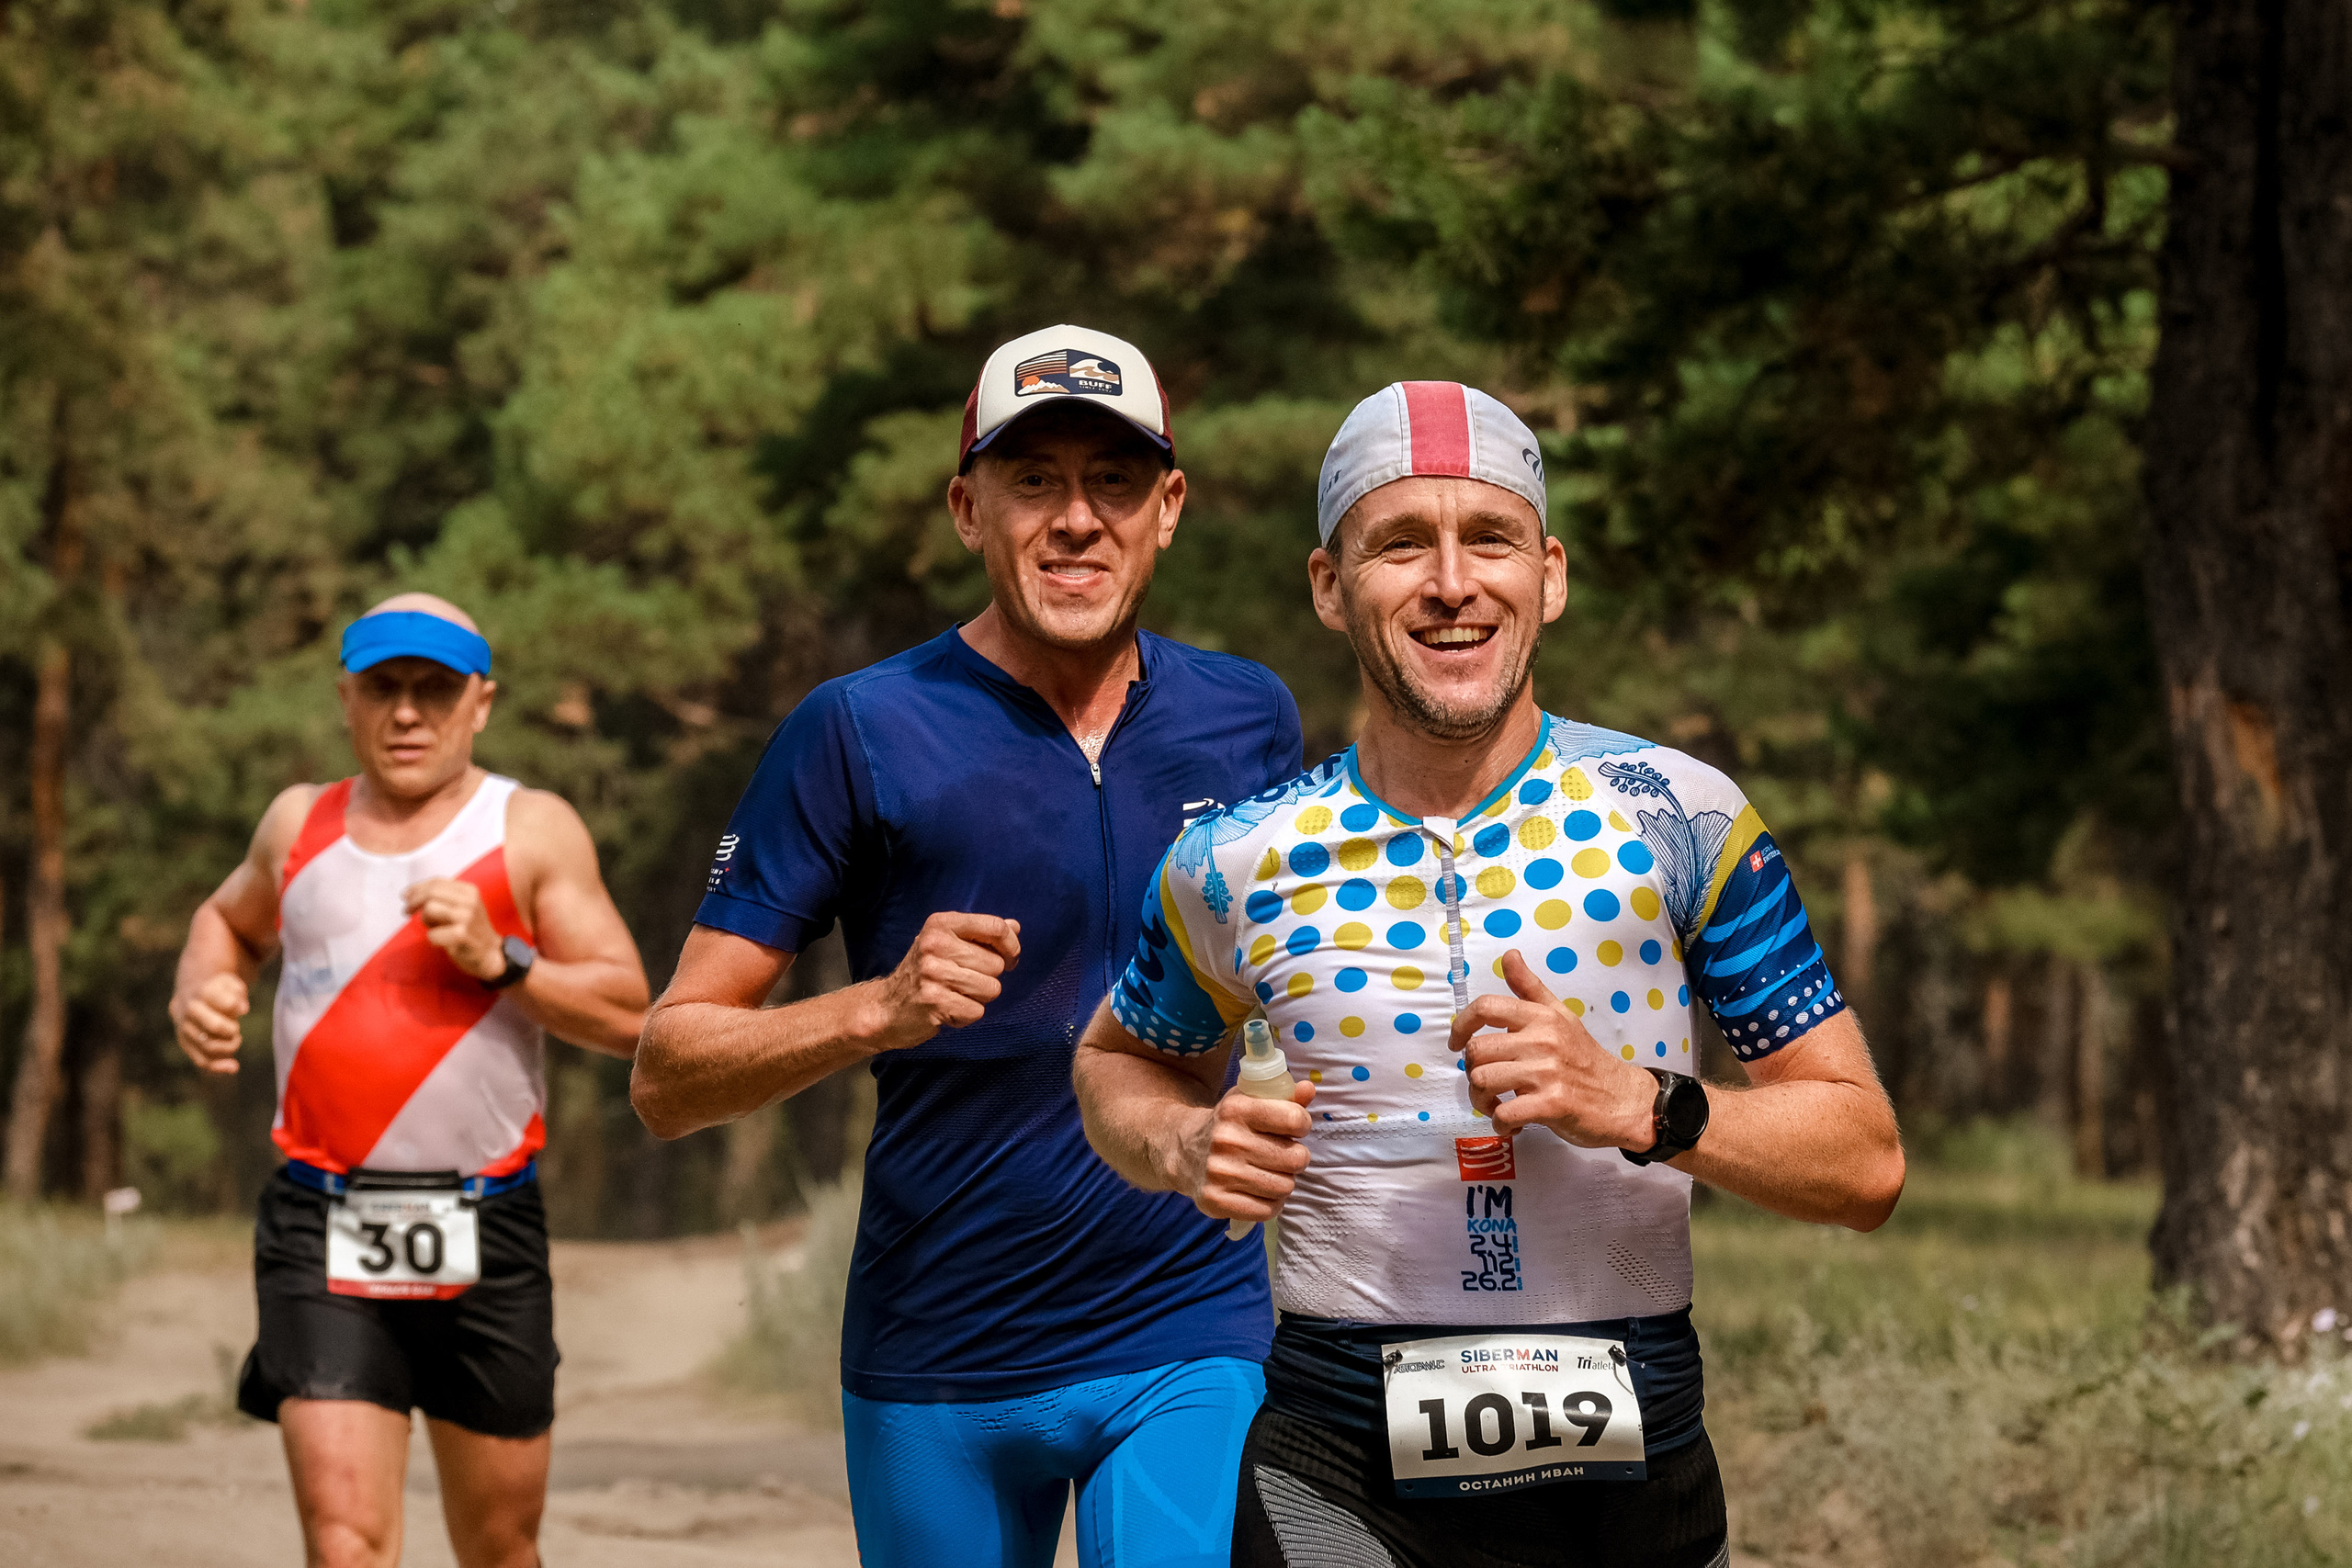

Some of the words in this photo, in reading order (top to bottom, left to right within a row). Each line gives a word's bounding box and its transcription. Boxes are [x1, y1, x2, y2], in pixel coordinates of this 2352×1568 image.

[1079, 380, 1112, 389] BUFF
[1466, 1185, 1512, 1218] I'M
[1467, 1218, 1517, 1234] KONA
[359, 1223, 443, 1274] 30
[1461, 1271, 1517, 1291] 26.2
[1461, 1348, 1558, 1363] SIBERMAN
[1462, 1364, 1497, 1373] ULTRA
[1419, 1392, 1612, 1461] 1019
[1459, 1472, 1535, 1491] ОСТАНИН
[1541, 1466, 1584, 1480] ИВАН
